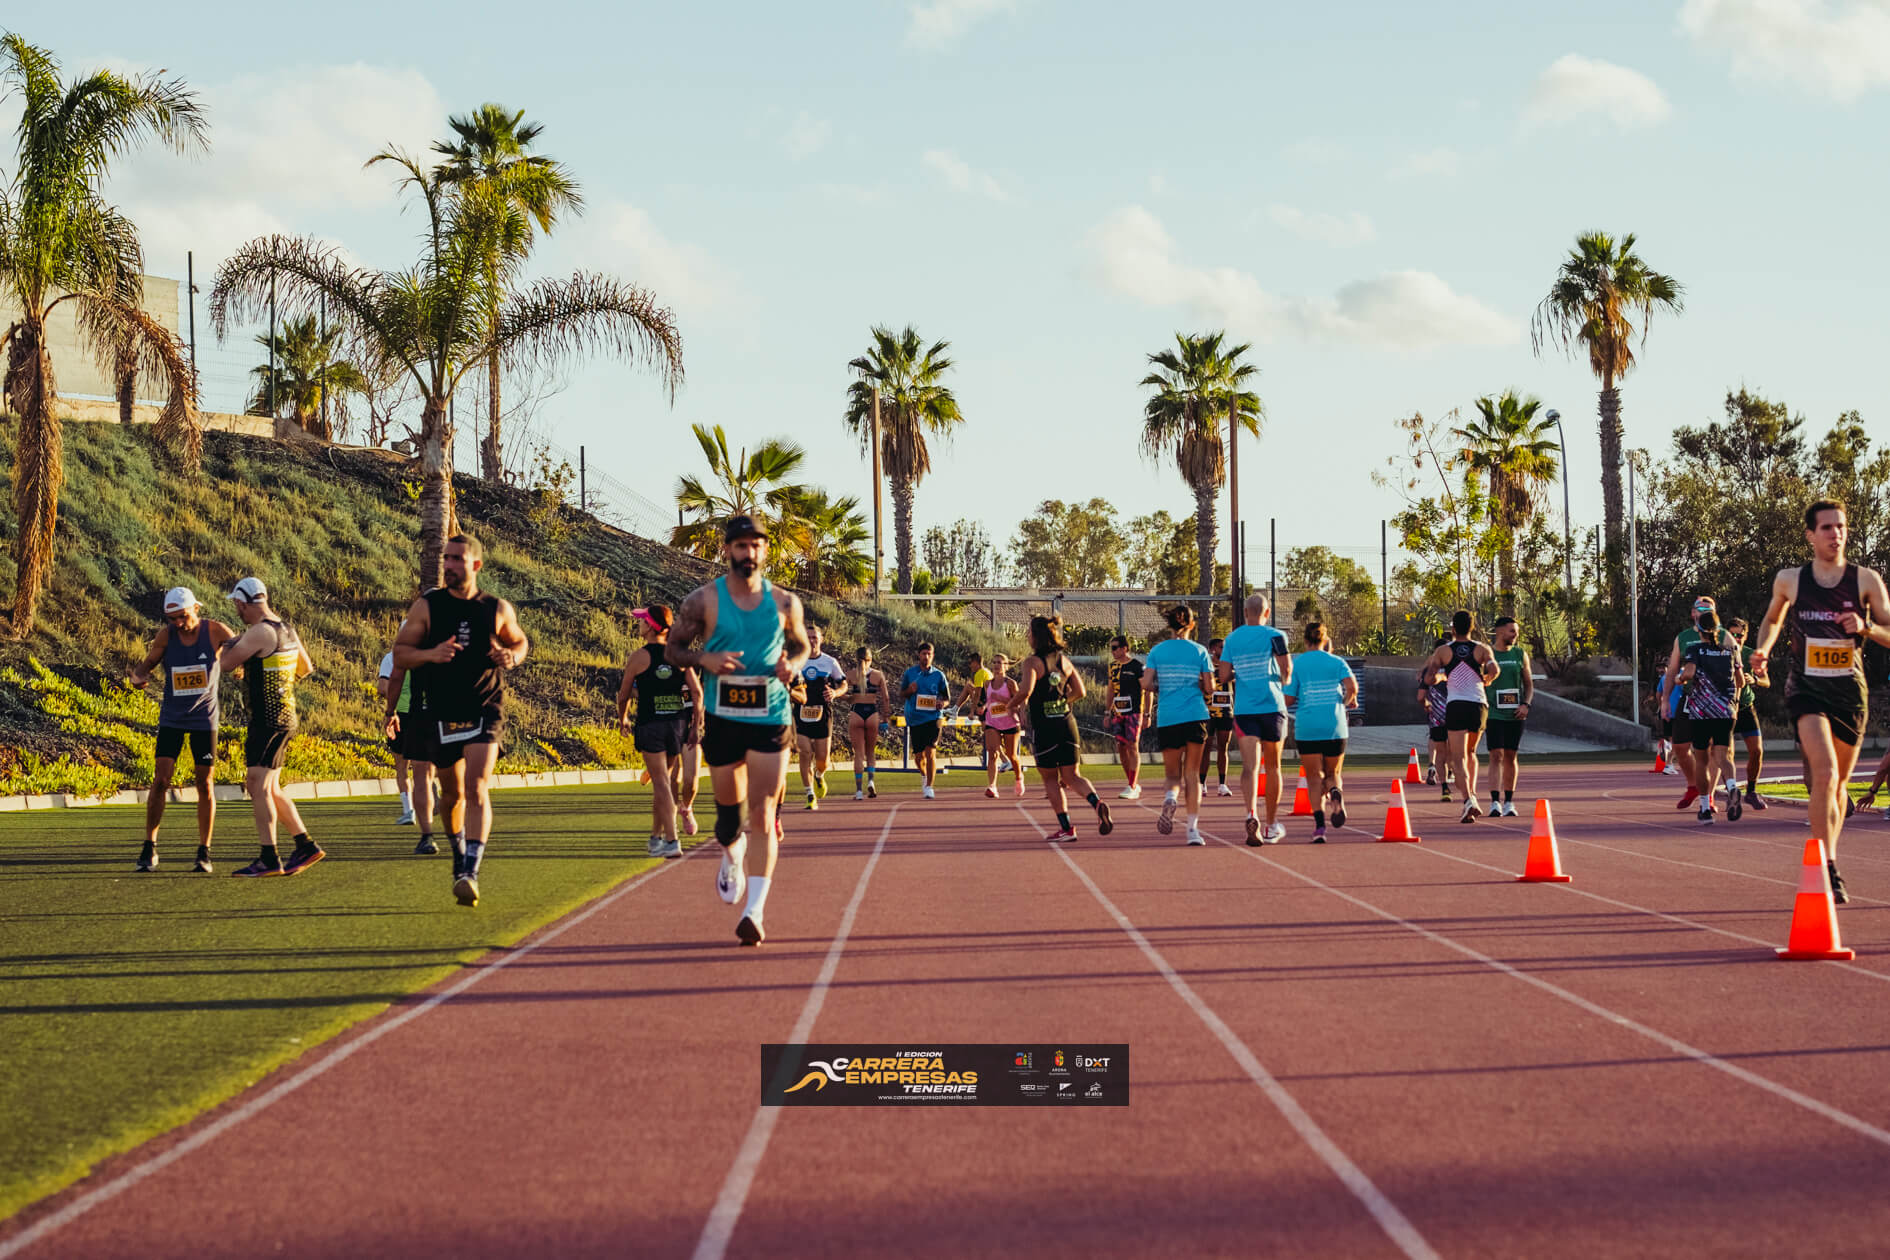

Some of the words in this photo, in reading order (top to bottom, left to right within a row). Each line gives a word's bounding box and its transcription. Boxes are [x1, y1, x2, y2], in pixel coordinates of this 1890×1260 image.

[1813, 651, 1849, 664] 1105
[176, 674, 203, 686] 1126
[728, 688, 757, 704] 931
